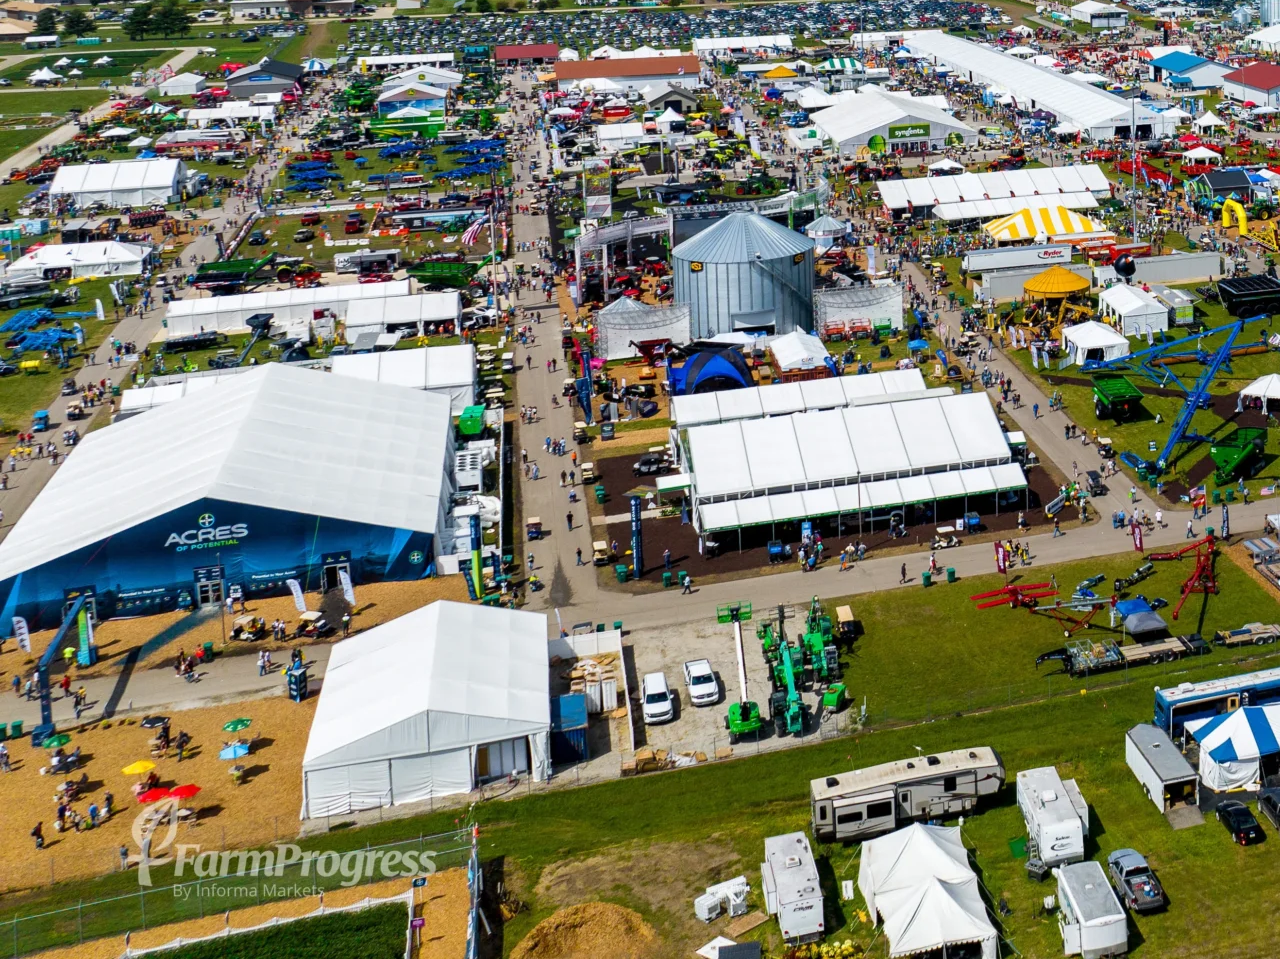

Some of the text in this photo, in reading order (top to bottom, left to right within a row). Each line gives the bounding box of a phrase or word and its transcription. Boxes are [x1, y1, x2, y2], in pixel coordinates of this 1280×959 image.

[895, 127, 924, 137] syngenta
[164, 523, 249, 547] ACRES
[176, 539, 239, 552] OF POTENTIAL
